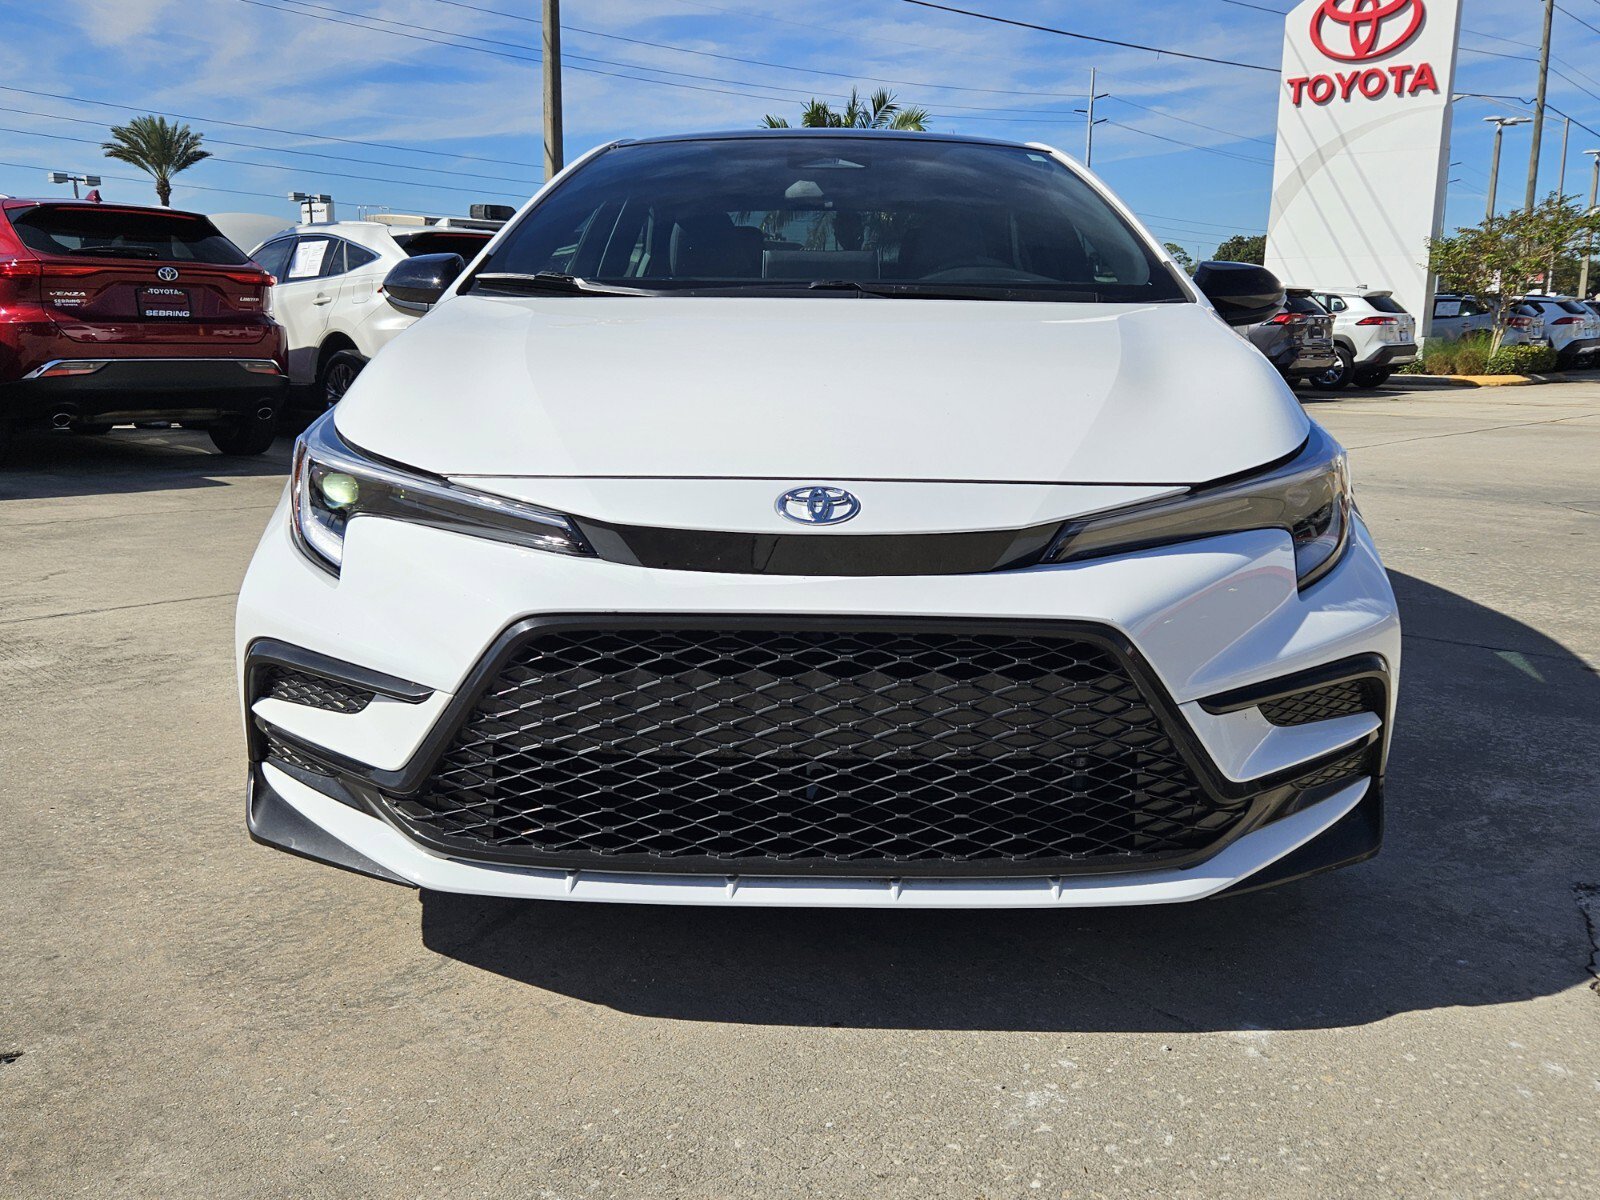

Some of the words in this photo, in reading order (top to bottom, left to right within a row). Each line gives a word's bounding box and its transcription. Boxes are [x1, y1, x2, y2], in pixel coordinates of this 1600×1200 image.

[1287, 62, 1438, 106] TOYOTA
[149, 287, 181, 295] TOYOTA
[145, 309, 190, 318] SEBRING
